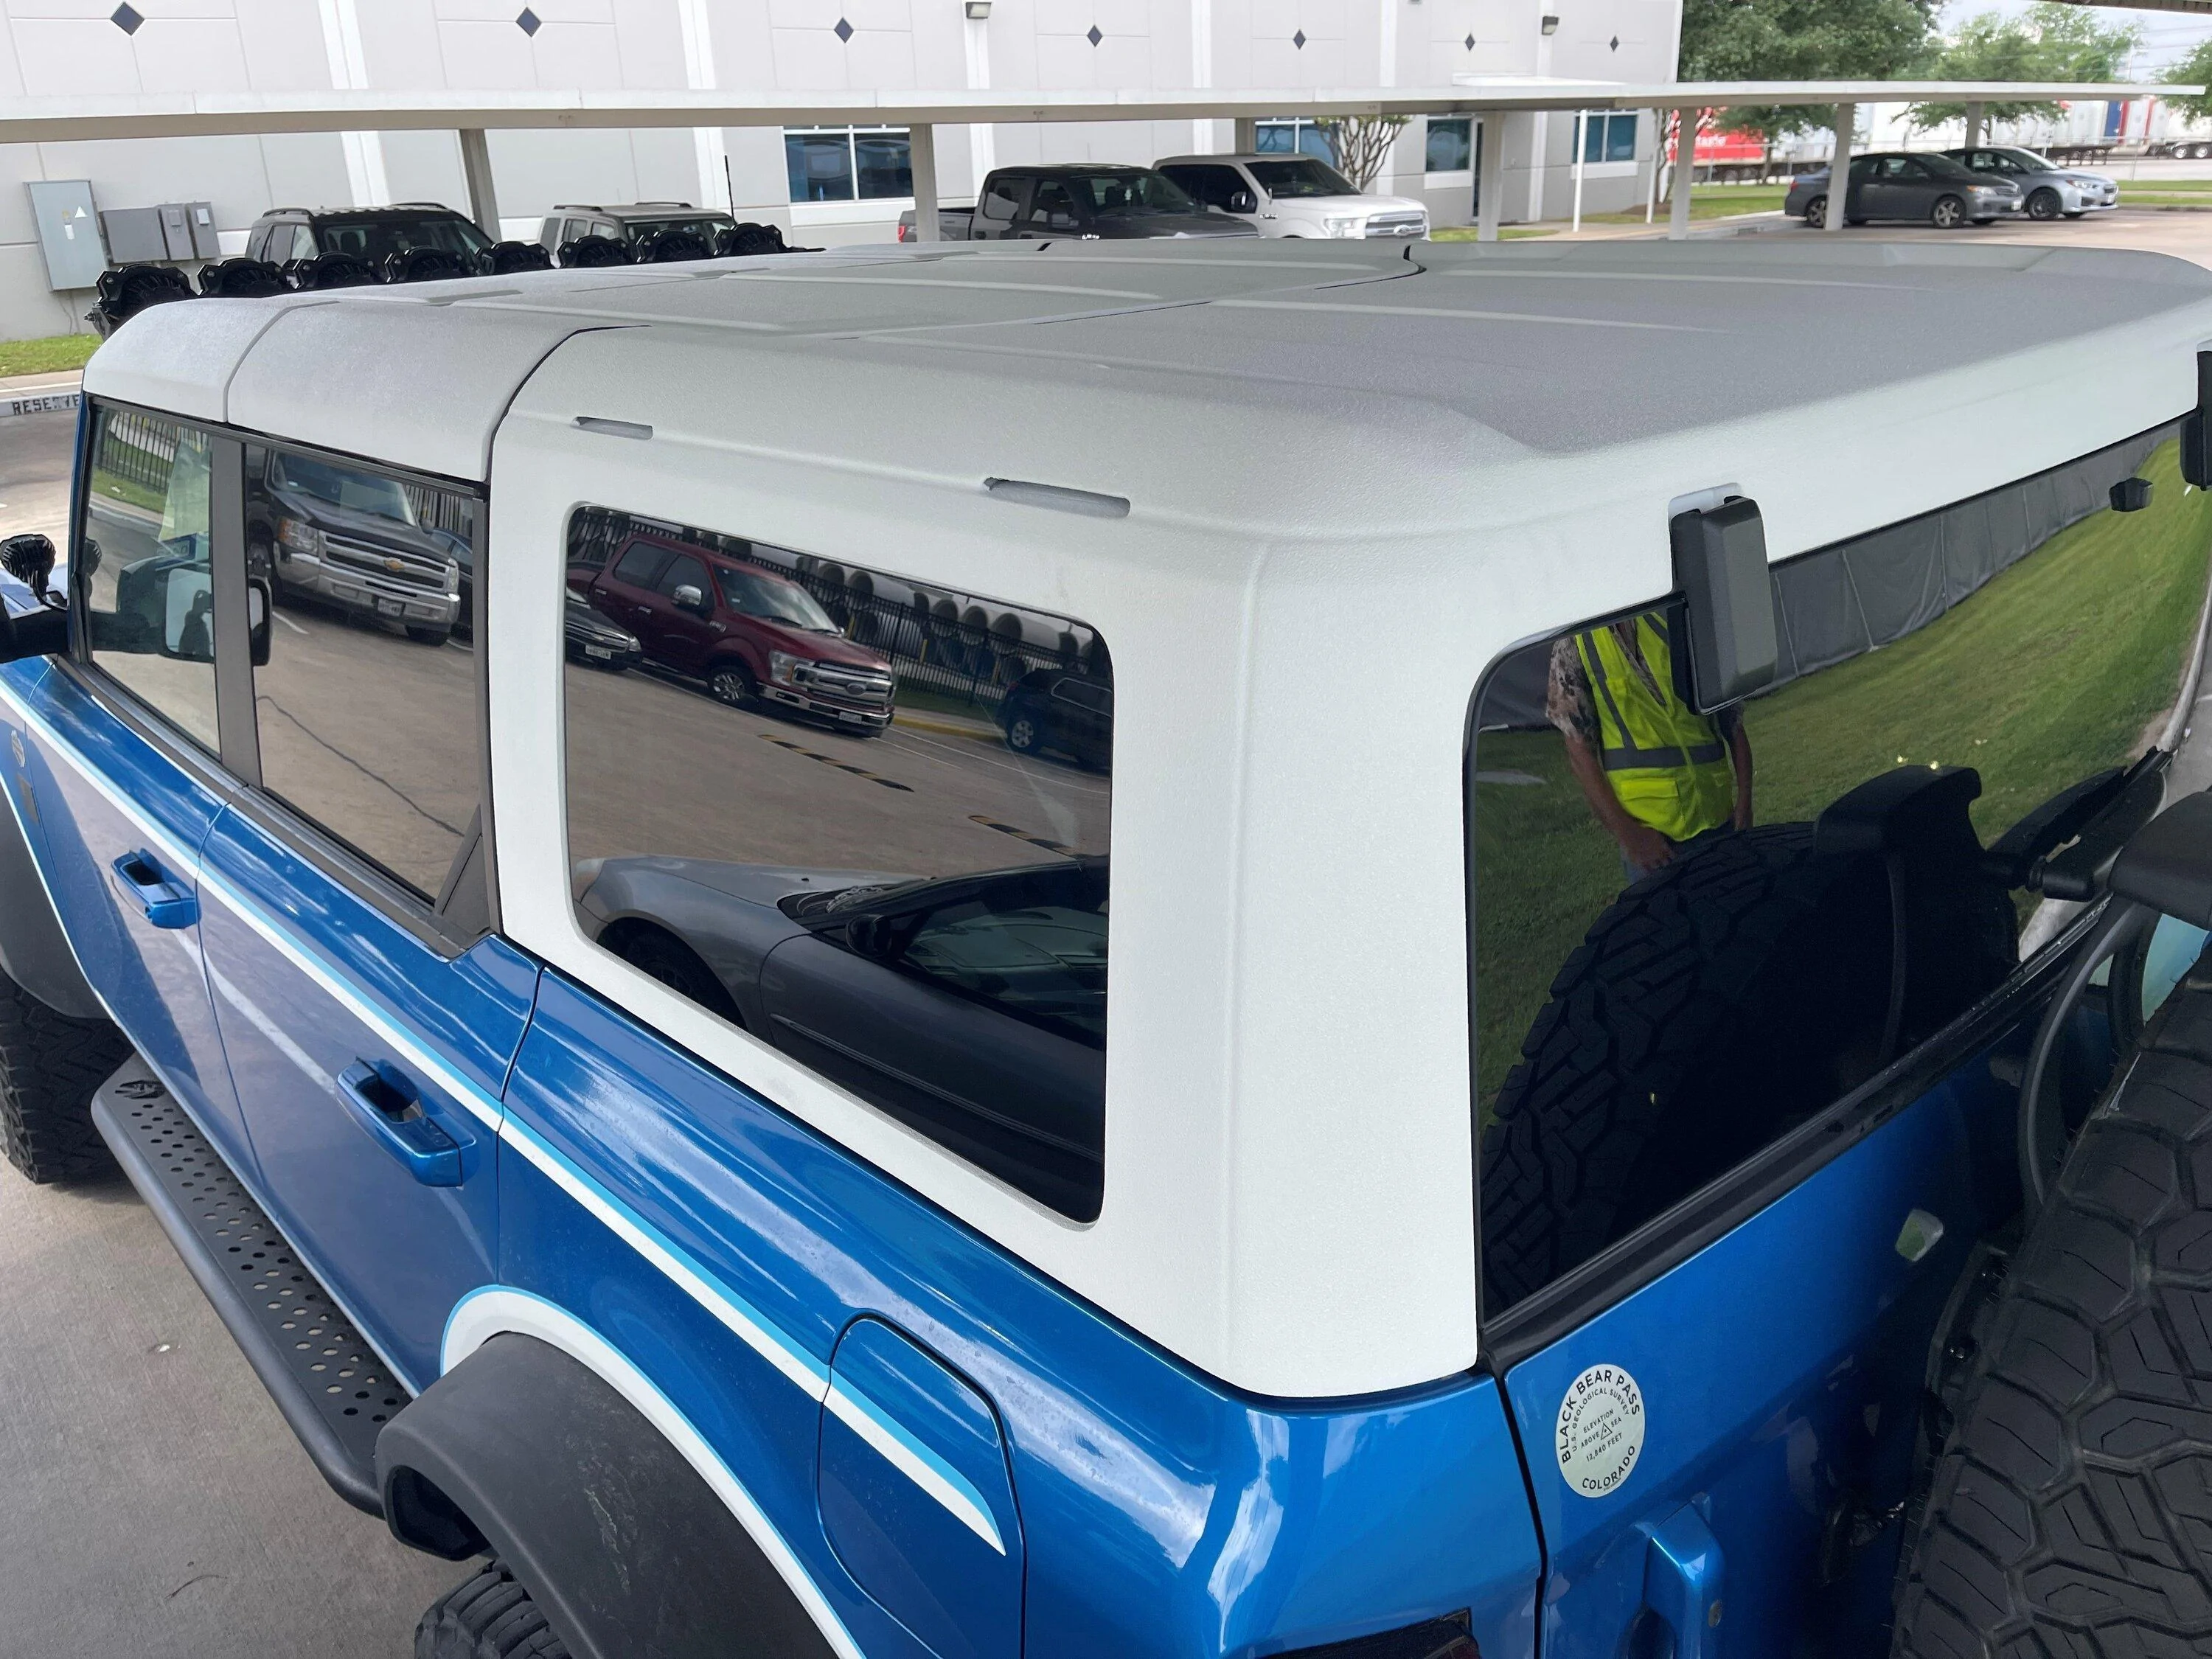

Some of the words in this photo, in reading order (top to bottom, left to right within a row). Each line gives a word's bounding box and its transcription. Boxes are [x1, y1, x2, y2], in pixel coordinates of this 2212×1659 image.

[1559, 1395, 1577, 1464] BLACK
[1576, 1369, 1612, 1395] BEAR
[1615, 1374, 1640, 1415] PASS
[1572, 1388, 1607, 1429] GEOLOGICAL
[1610, 1388, 1630, 1416] SURVEY
[1583, 1408, 1614, 1433] ELEVATION
[1581, 1431, 1600, 1449] ABOVE
[1611, 1416, 1622, 1427] SEA
[1586, 1445, 1607, 1462] 12,840
[1607, 1432, 1623, 1447] FEET
[1582, 1445, 1635, 1489] COLORADO
